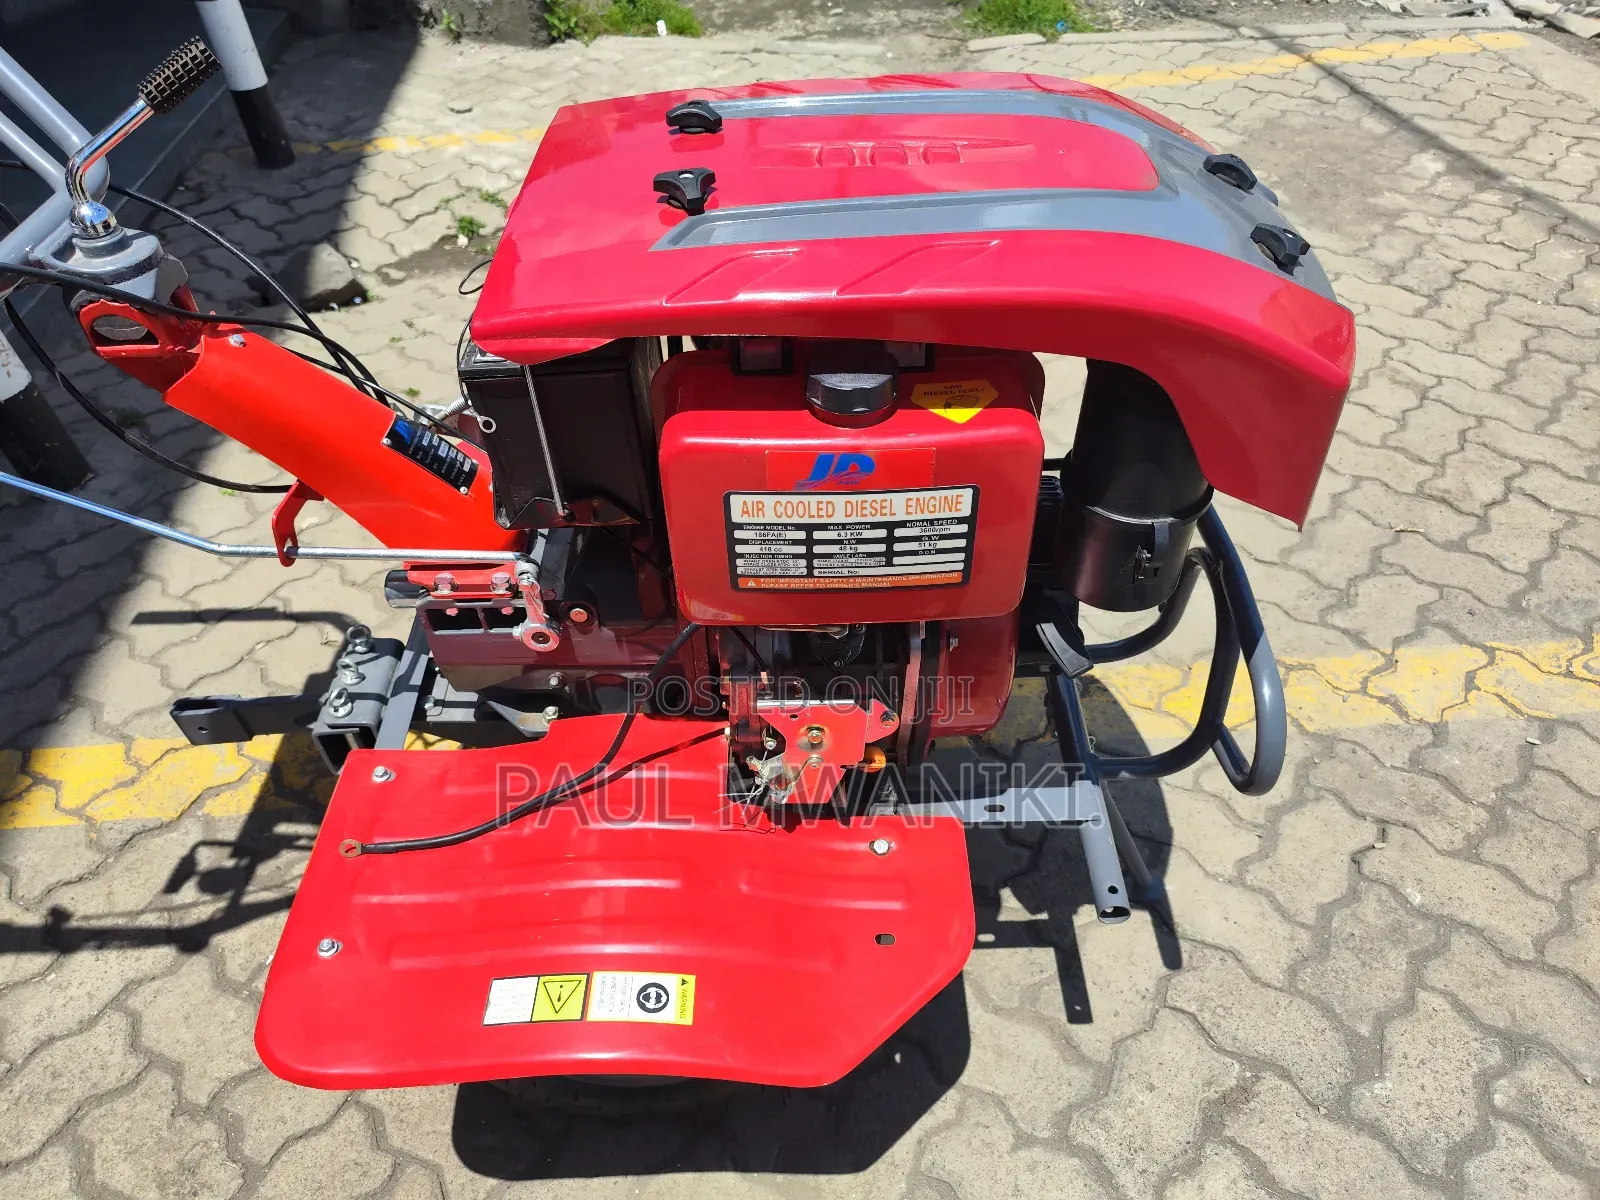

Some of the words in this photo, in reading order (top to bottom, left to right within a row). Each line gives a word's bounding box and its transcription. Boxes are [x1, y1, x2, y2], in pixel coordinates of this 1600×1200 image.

[740, 499, 766, 519] AIR
[773, 500, 836, 519] COOLED
[844, 498, 897, 518] DIESEL
[904, 494, 964, 516] ENGINE
[857, 575, 907, 583] MAINTENANCE
[678, 988, 688, 1019] WARNING
